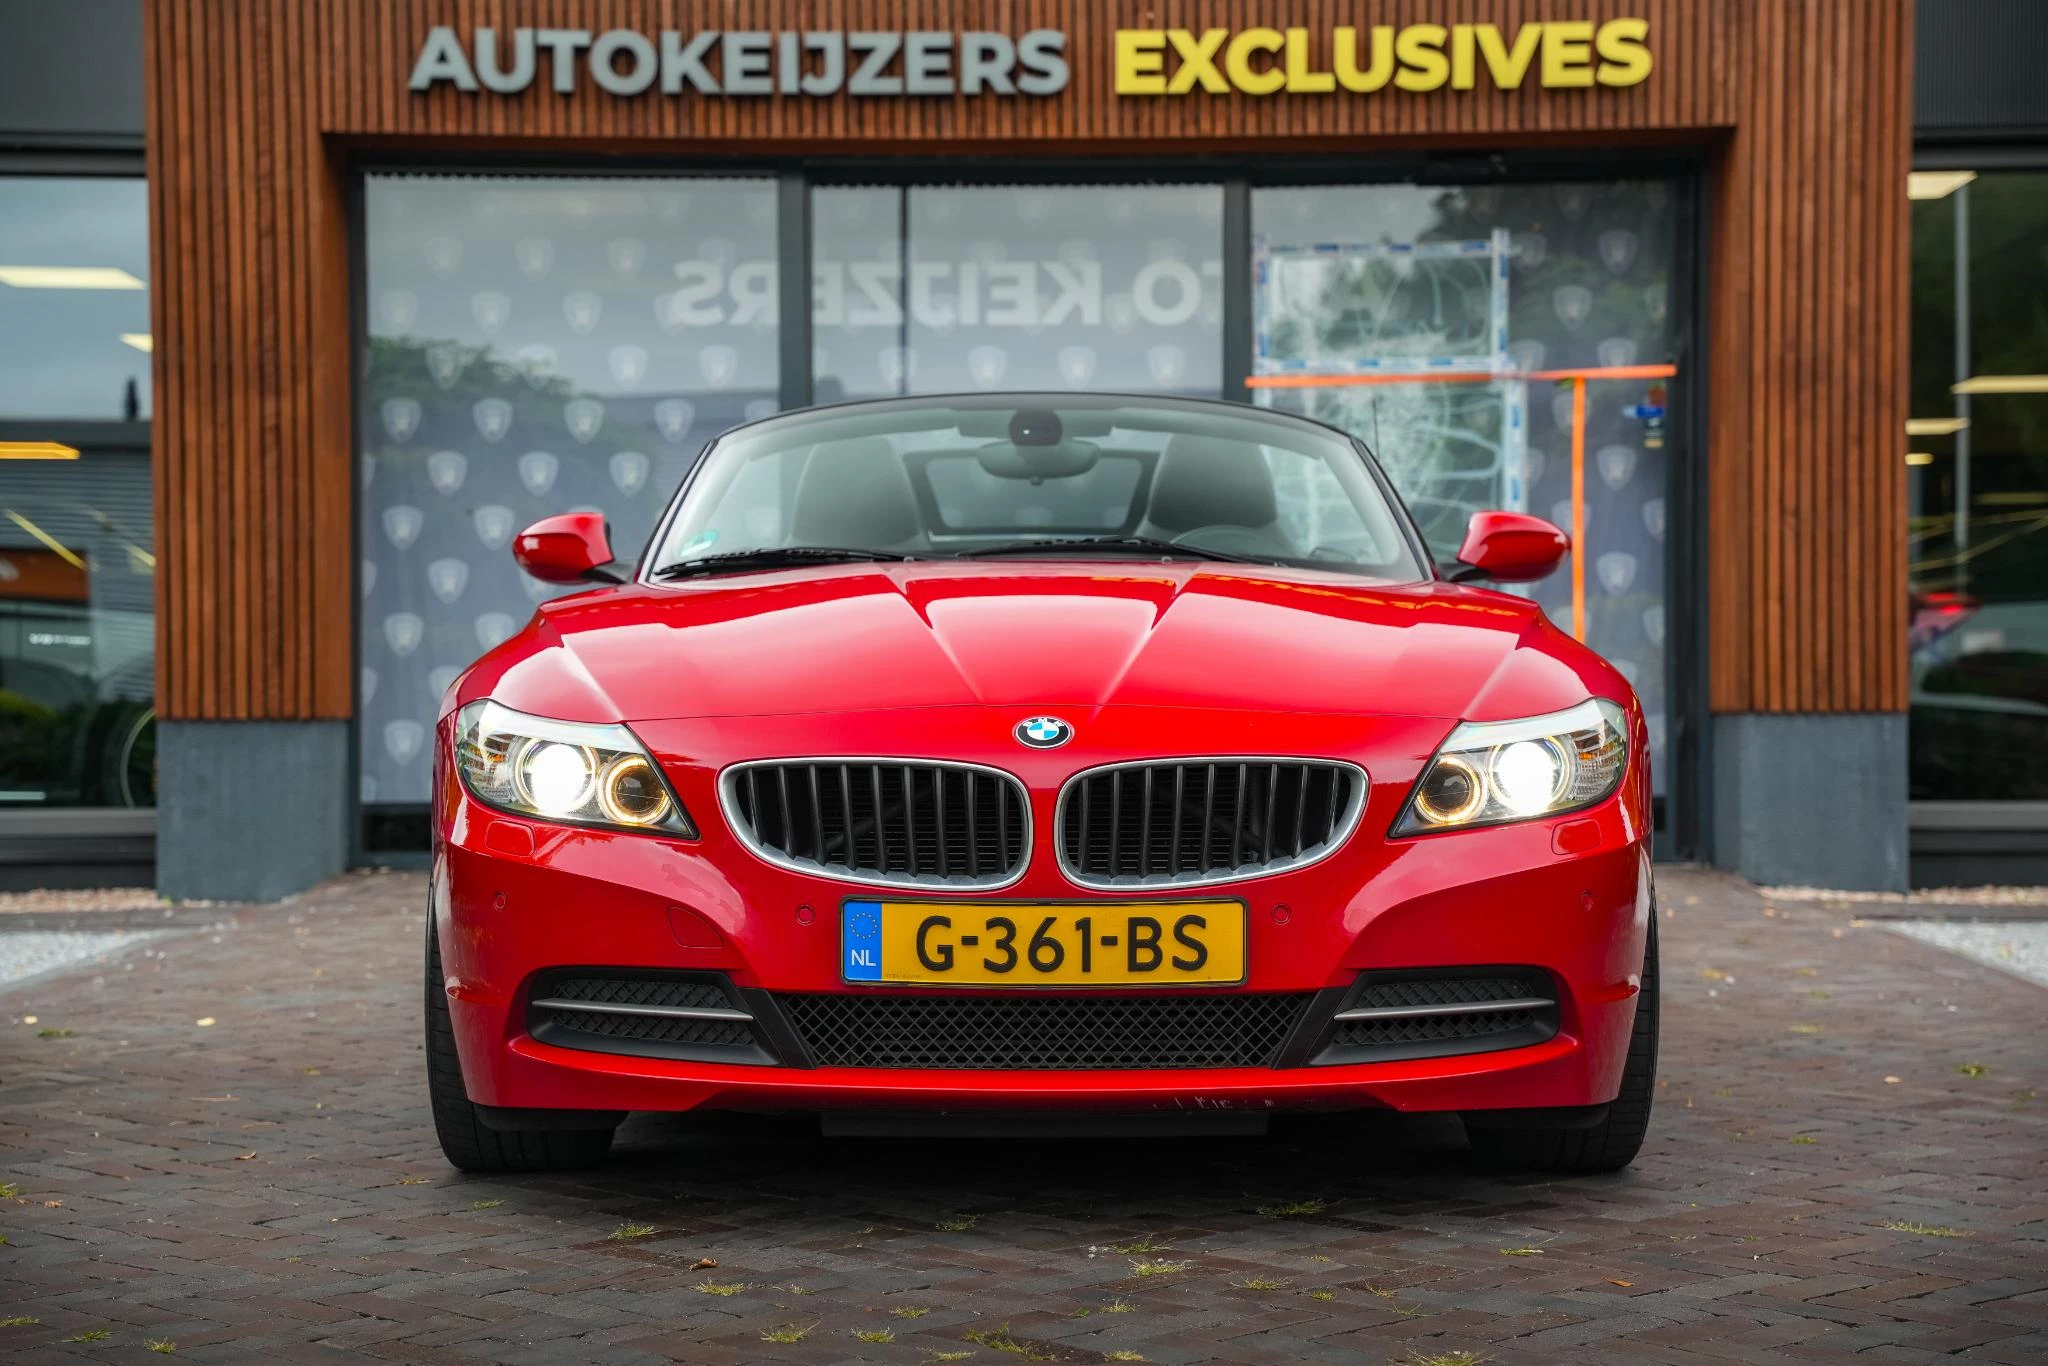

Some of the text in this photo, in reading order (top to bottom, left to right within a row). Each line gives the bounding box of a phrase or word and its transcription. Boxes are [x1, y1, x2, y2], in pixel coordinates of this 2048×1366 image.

[408, 18, 1653, 95] AUTOKEIJZERS EXCLUSIVES
[851, 949, 877, 967] NL
[916, 915, 1208, 973] G-361-BS
